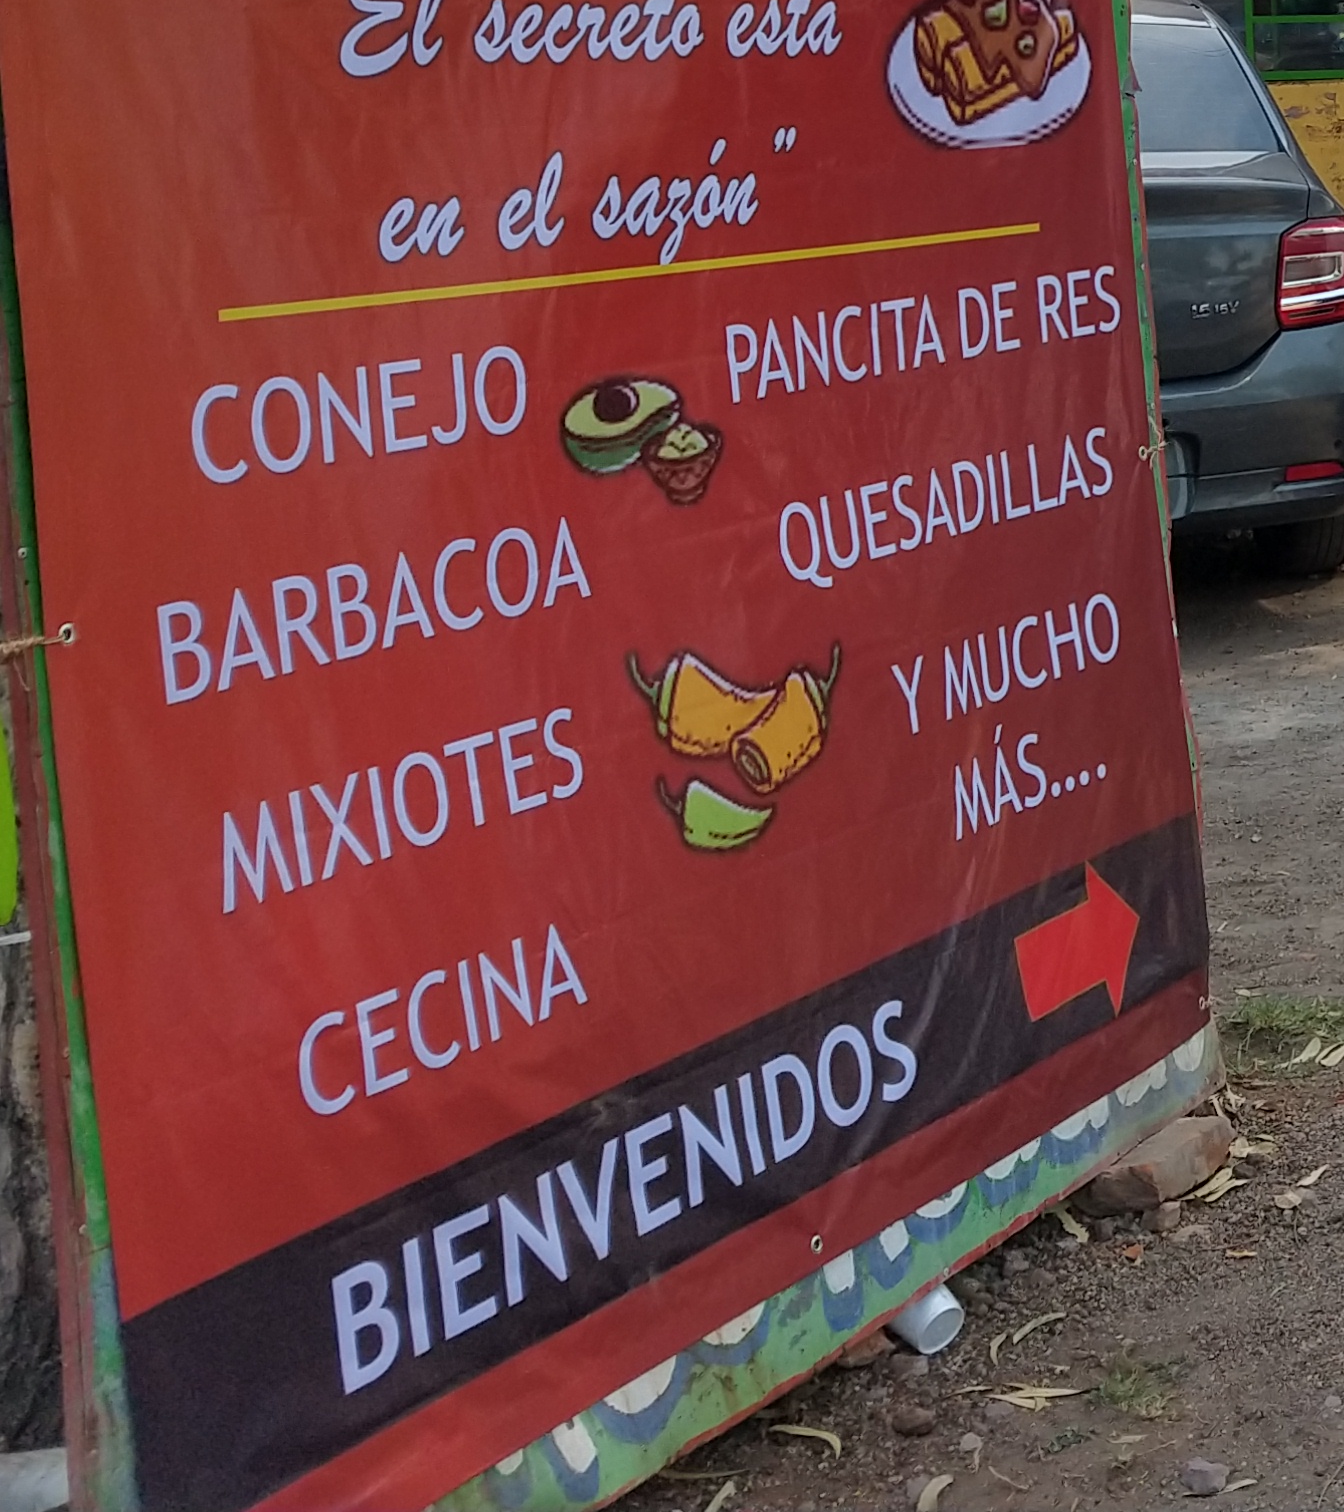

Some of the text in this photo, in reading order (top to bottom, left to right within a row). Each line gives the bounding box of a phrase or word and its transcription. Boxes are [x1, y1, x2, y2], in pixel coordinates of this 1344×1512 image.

[378, 191, 464, 263] en
[496, 151, 565, 250] el
[189, 345, 529, 484] CONEJO
[726, 266, 1121, 404] PANCITA DE RES
[778, 426, 1115, 589] QUESADILLAS
[156, 516, 592, 706] BARBACOA
[892, 593, 1121, 735] Y MUCHO
[220, 707, 585, 914] MIXIOTES
[298, 922, 588, 1115] CECINA
[330, 998, 918, 1396] BIENVENIDOS
